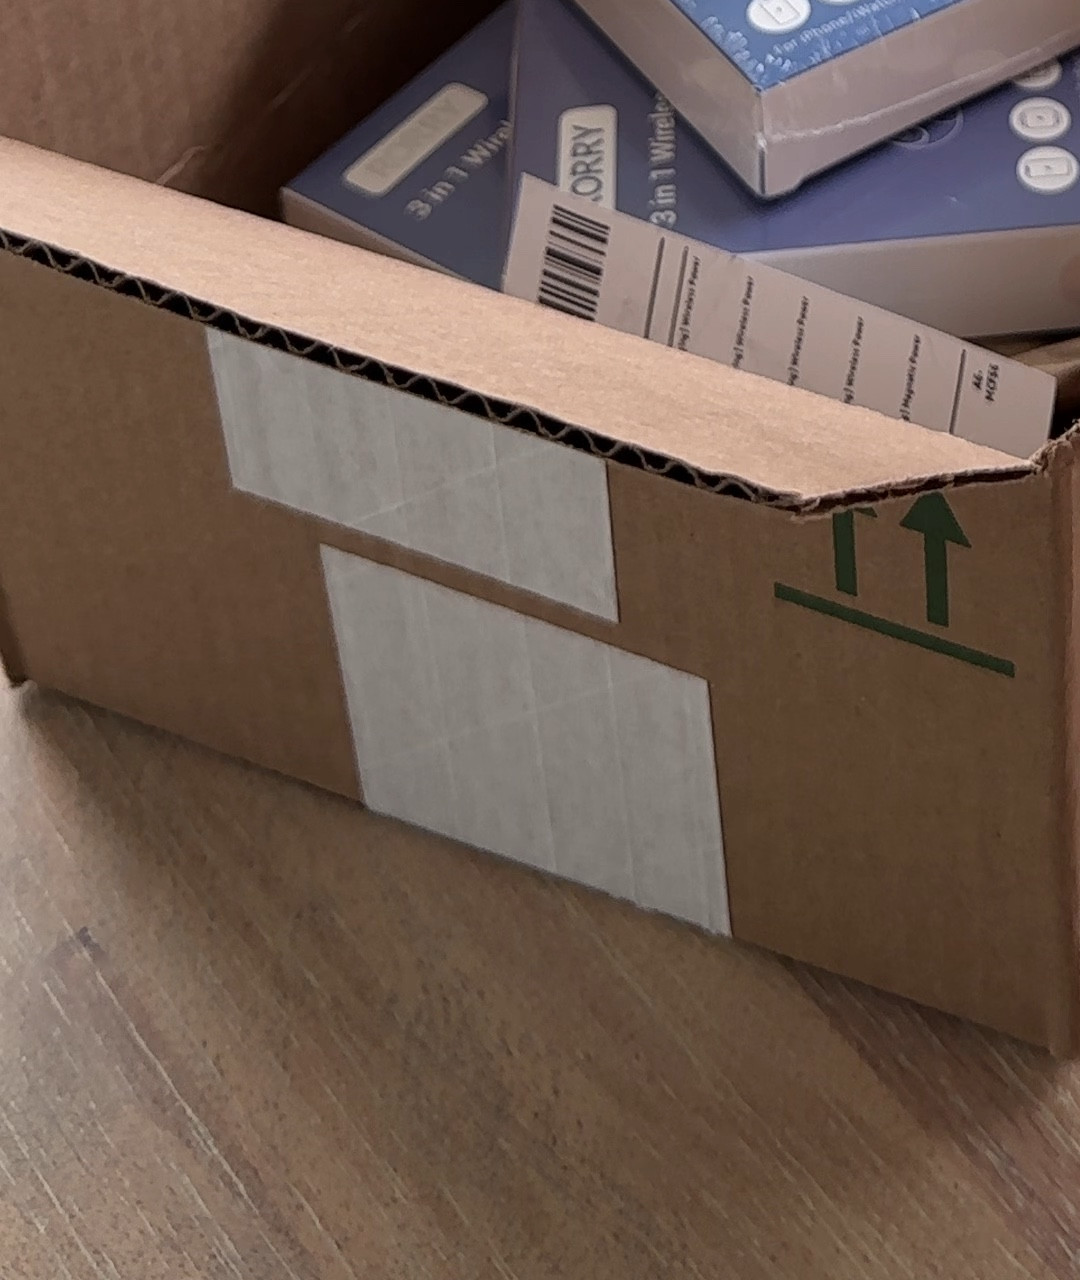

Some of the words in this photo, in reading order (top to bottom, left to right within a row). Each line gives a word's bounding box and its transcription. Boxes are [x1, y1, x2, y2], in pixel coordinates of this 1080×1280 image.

[570, 123, 606, 204] ORRY
[648, 167, 677, 183] 1
[404, 198, 432, 221] 3
[421, 181, 455, 203] in
[444, 165, 469, 182] 1
[648, 183, 678, 208] in
[648, 209, 678, 229] 3
